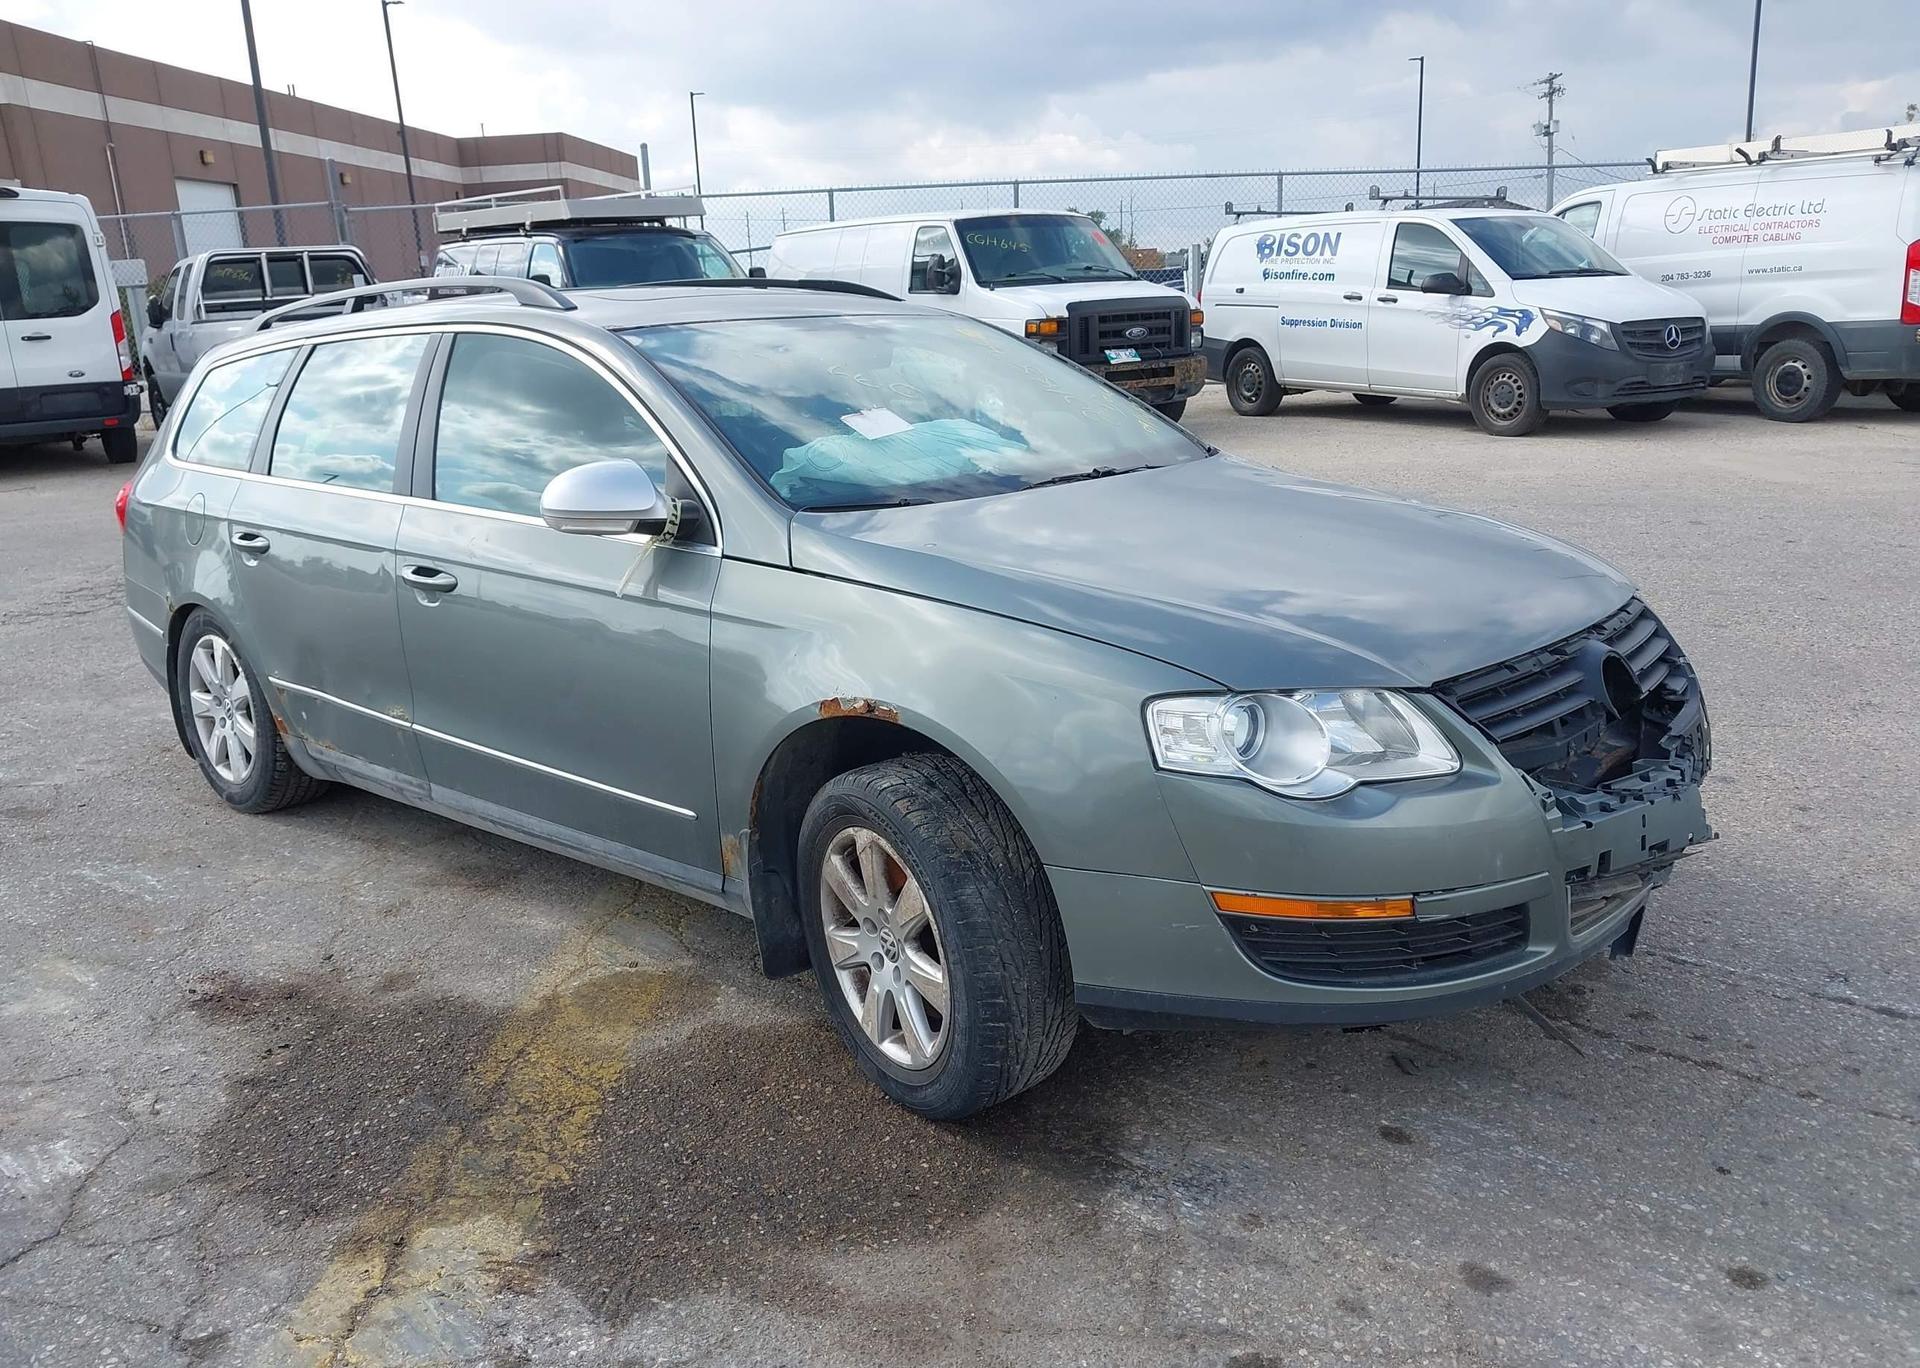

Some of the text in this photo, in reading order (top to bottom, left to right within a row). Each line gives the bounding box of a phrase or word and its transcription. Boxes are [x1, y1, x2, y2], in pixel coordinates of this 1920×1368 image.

[1697, 198, 1828, 221] Static Electric Ltd.
[1698, 218, 1821, 235] ELECTRICAL CONTRACTORS
[1712, 231, 1802, 245] COMPUTER CABLING
[1256, 232, 1342, 263] BISON
[1265, 257, 1279, 265] FIRE
[1280, 257, 1321, 265] PROTECTION
[1262, 267, 1335, 281] Bisonfire.com
[1661, 269, 1712, 283] 204 783-3236
[1748, 264, 1803, 275] www.static.ca
[1280, 316, 1363, 330] Suppression Division
